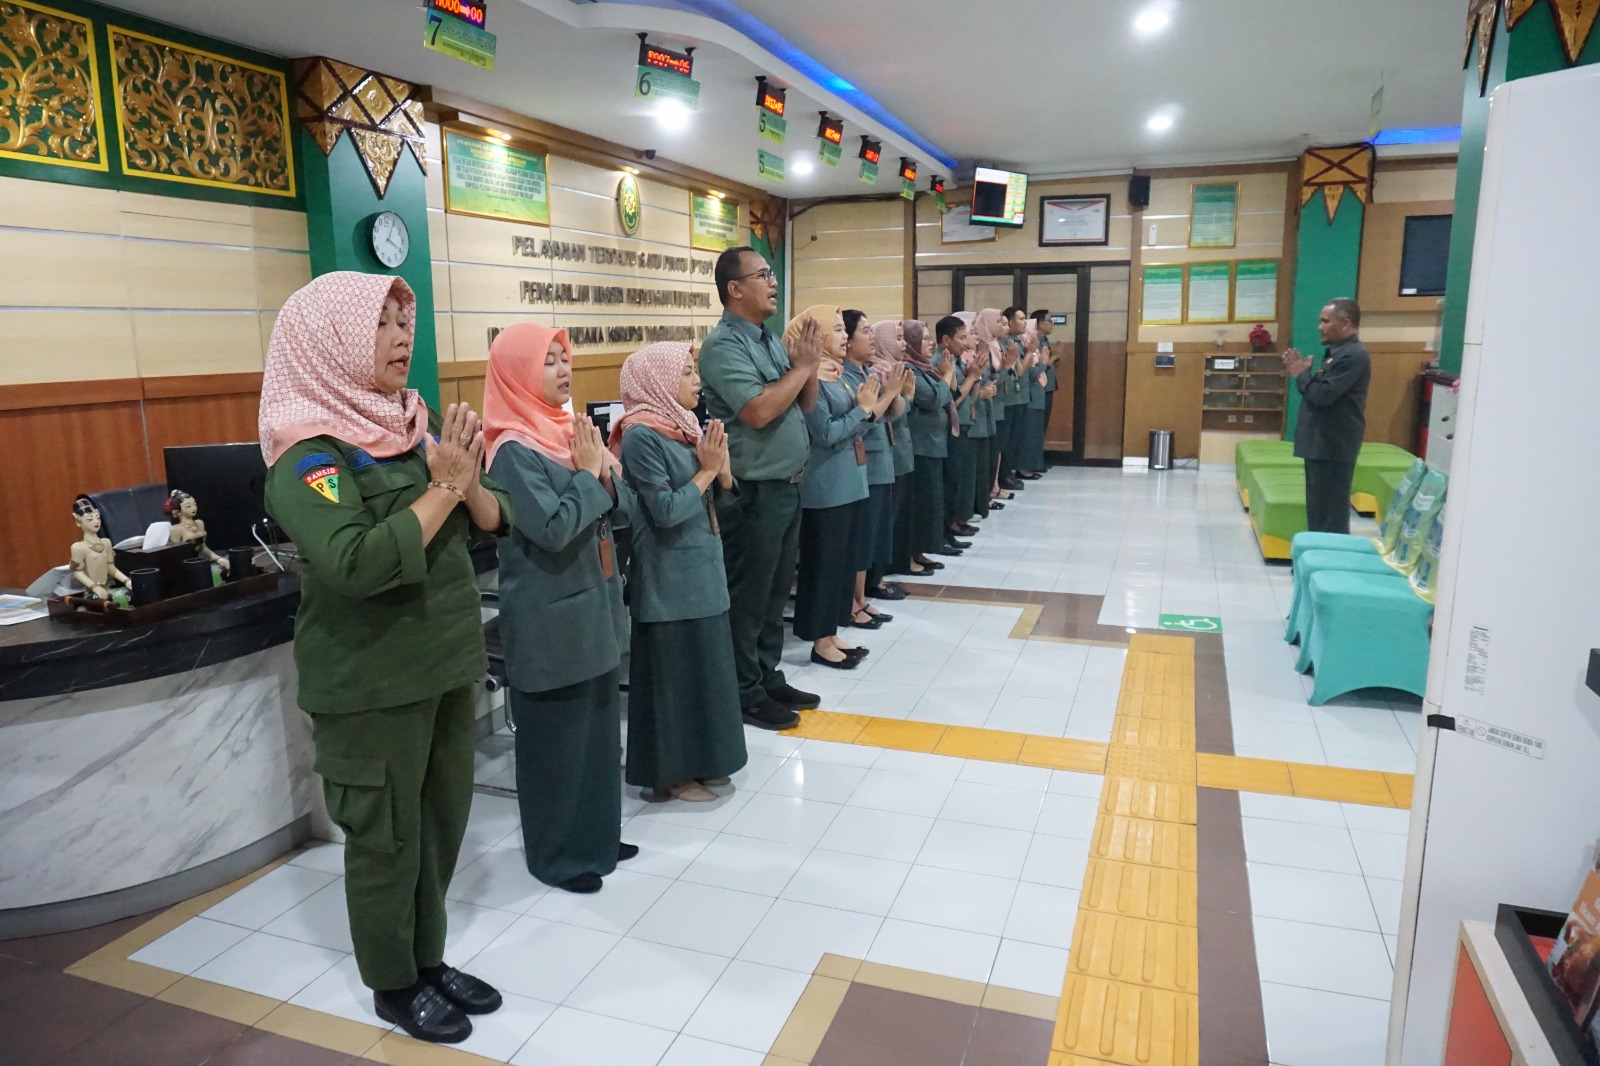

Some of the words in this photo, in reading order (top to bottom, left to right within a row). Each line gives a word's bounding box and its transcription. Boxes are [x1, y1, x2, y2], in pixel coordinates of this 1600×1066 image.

[429, 13, 443, 46] 7
[639, 72, 651, 96] 6
[759, 112, 766, 133] 5
[759, 154, 765, 174] 5
[316, 483, 325, 492] P
[328, 478, 337, 489] S
